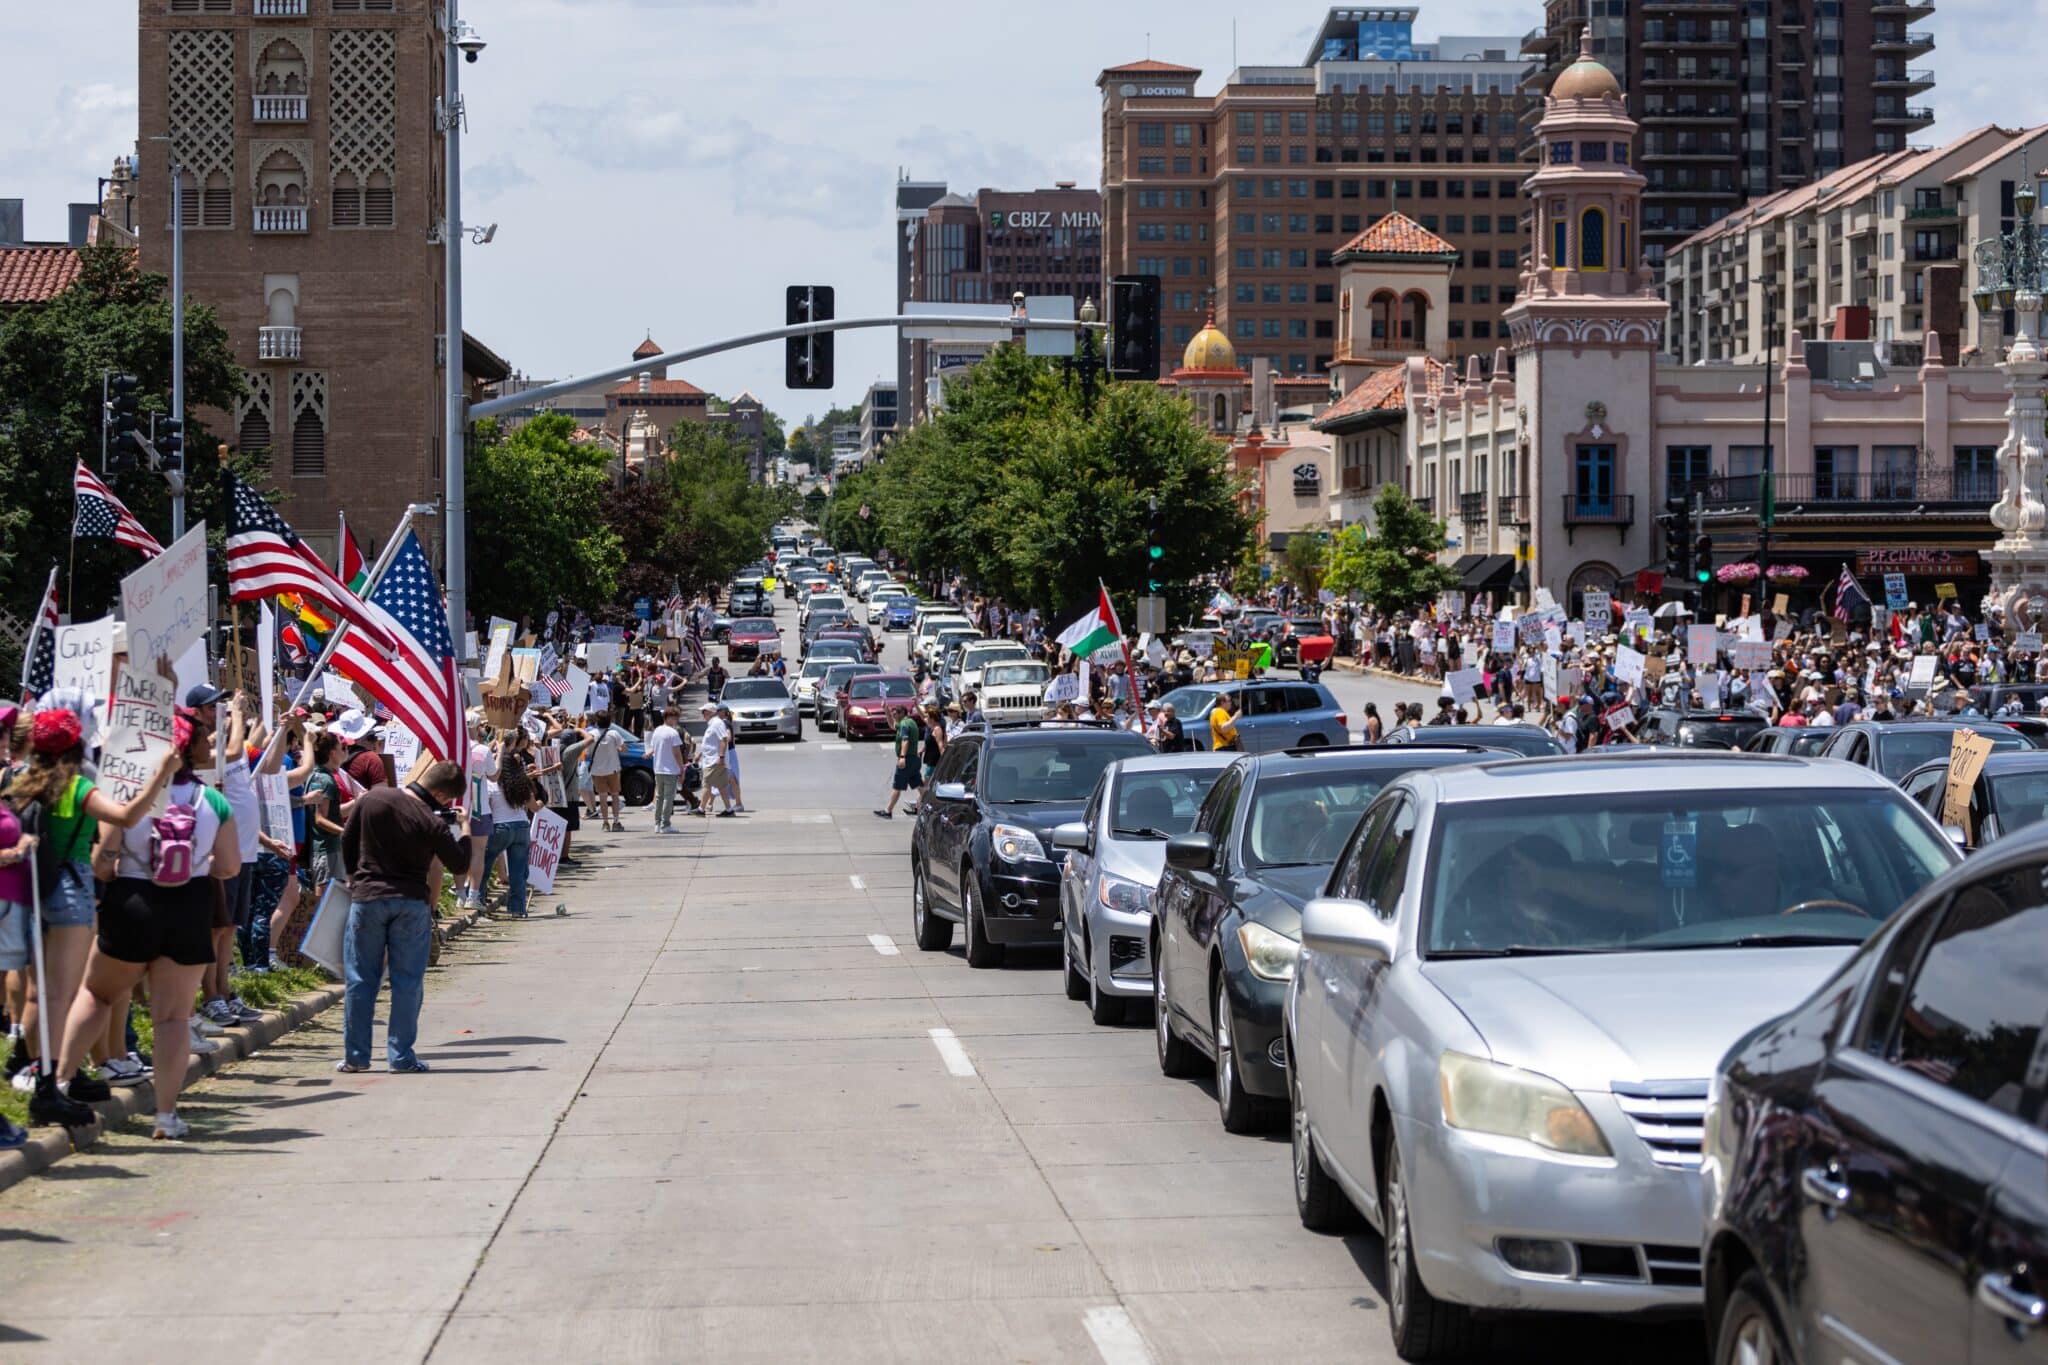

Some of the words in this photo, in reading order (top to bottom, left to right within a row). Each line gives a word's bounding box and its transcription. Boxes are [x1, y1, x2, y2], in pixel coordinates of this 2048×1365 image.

[1008, 211, 1052, 228] CBIZ
[1061, 211, 1104, 228] MHM
[117, 671, 160, 702] POWER
[113, 703, 141, 728] THE
[103, 753, 146, 782] PEOPLE
[536, 818, 560, 849] FUCK
